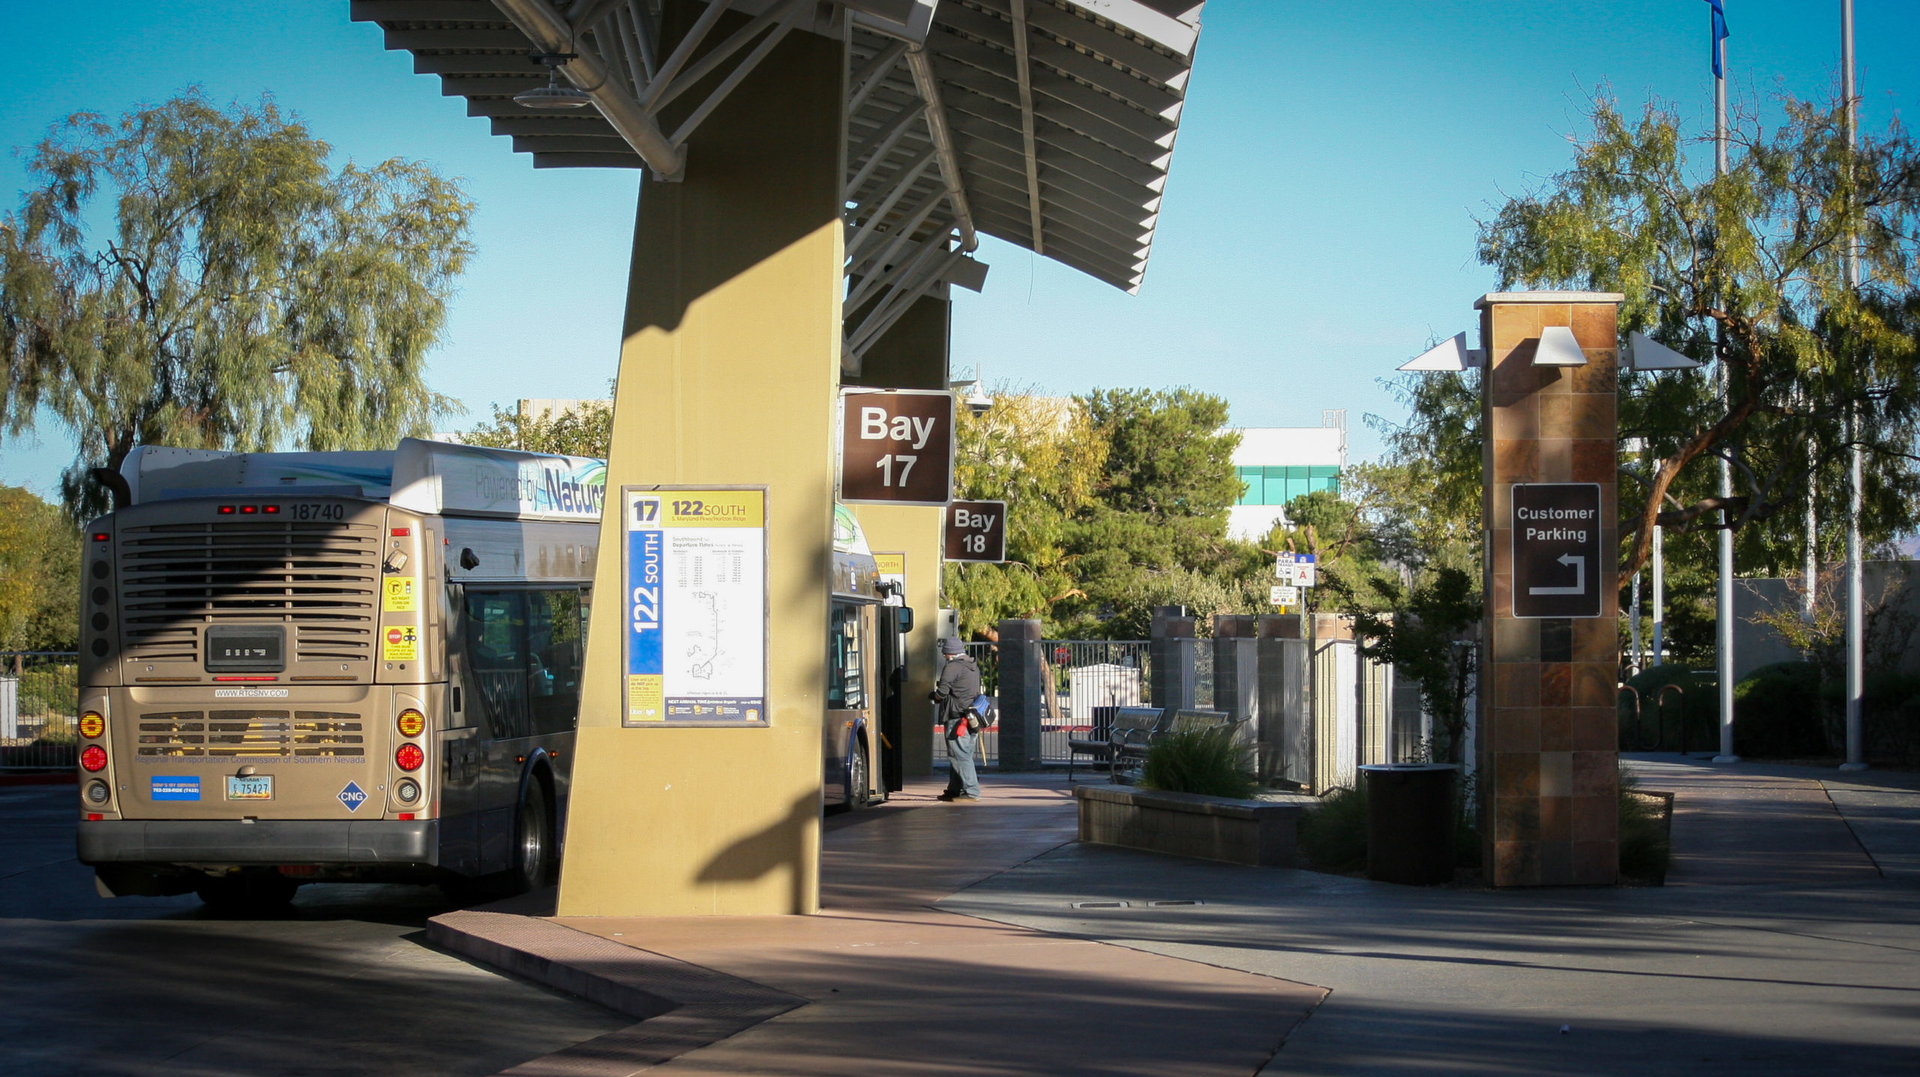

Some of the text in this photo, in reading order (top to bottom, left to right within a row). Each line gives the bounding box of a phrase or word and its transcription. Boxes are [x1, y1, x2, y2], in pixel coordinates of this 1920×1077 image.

[860, 406, 936, 450] Bay
[876, 453, 918, 488] 17
[475, 466, 522, 501] Powered
[526, 469, 538, 511] by
[290, 504, 344, 520] 18740
[633, 500, 659, 522] 17
[671, 500, 746, 516] 122 SOUTH
[1517, 506, 1595, 520] Customer
[954, 508, 995, 533] Bay
[1526, 527, 1587, 543] Parking
[962, 534, 985, 553] 18
[633, 533, 659, 633] 122 SOUTH
[1299, 570, 1307, 580] A
[215, 689, 288, 697] WWW.RTCSNV.COM
[135, 755, 366, 764] Regional Transportation Commission of Southern Nevada
[241, 783, 268, 795] 75427
[340, 792, 363, 801] CNG
